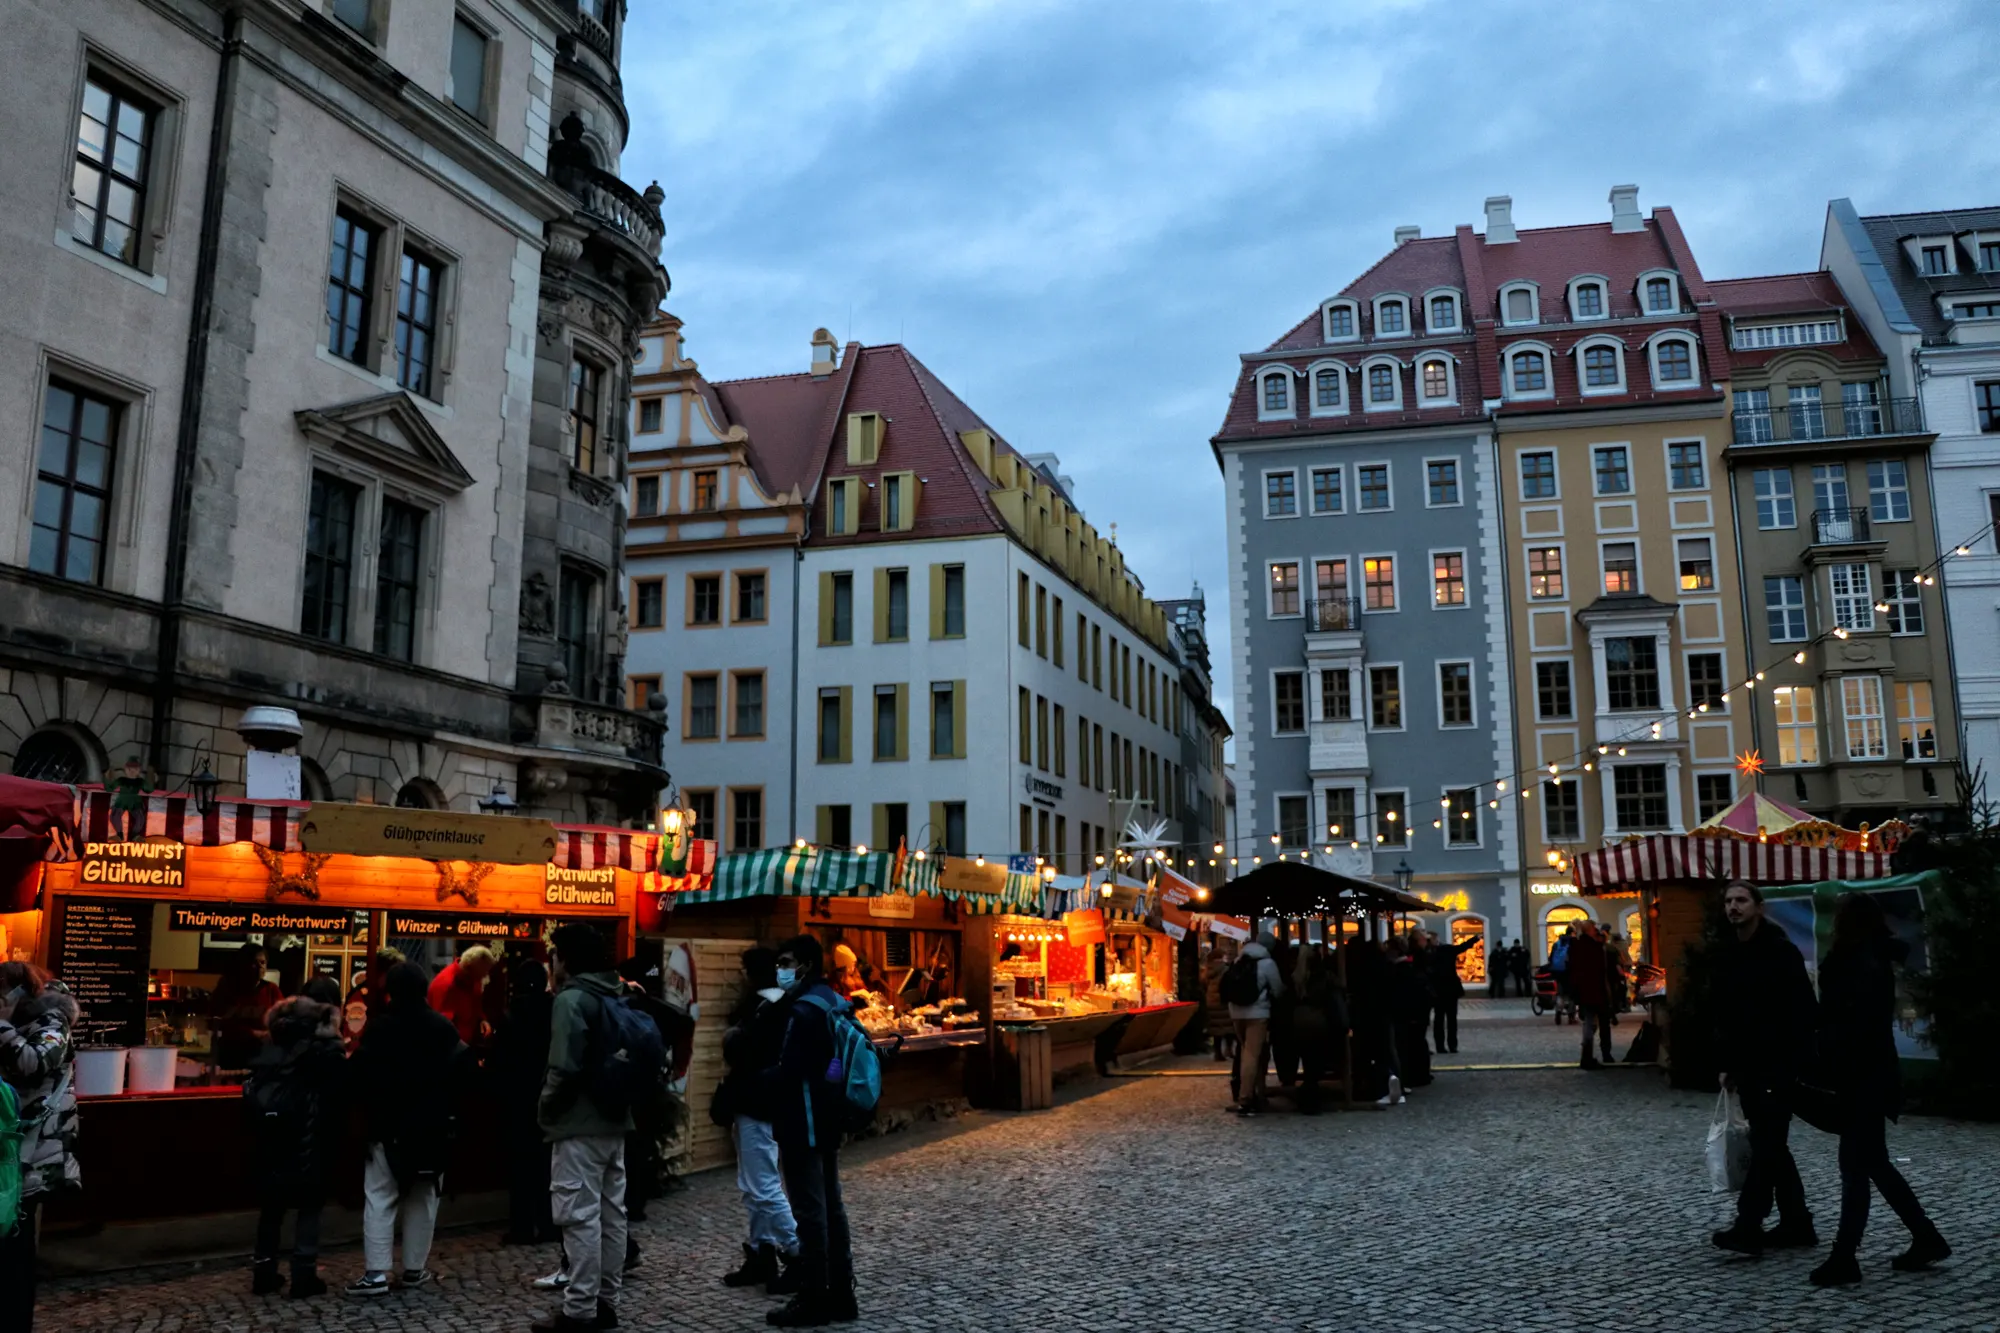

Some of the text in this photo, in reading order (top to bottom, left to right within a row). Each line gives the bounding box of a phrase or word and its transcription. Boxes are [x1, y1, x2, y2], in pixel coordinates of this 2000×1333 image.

[383, 825, 486, 845] Glühweinklause
[86, 842, 185, 860] Bratwurst
[83, 860, 183, 885] Glühwein
[546, 862, 615, 883] Bratwurst
[546, 884, 615, 905] Glühwein
[176, 909, 348, 931] Thüringer Rostbratwurst
[396, 918, 441, 933] Winzer
[457, 919, 509, 935] Glühwein
